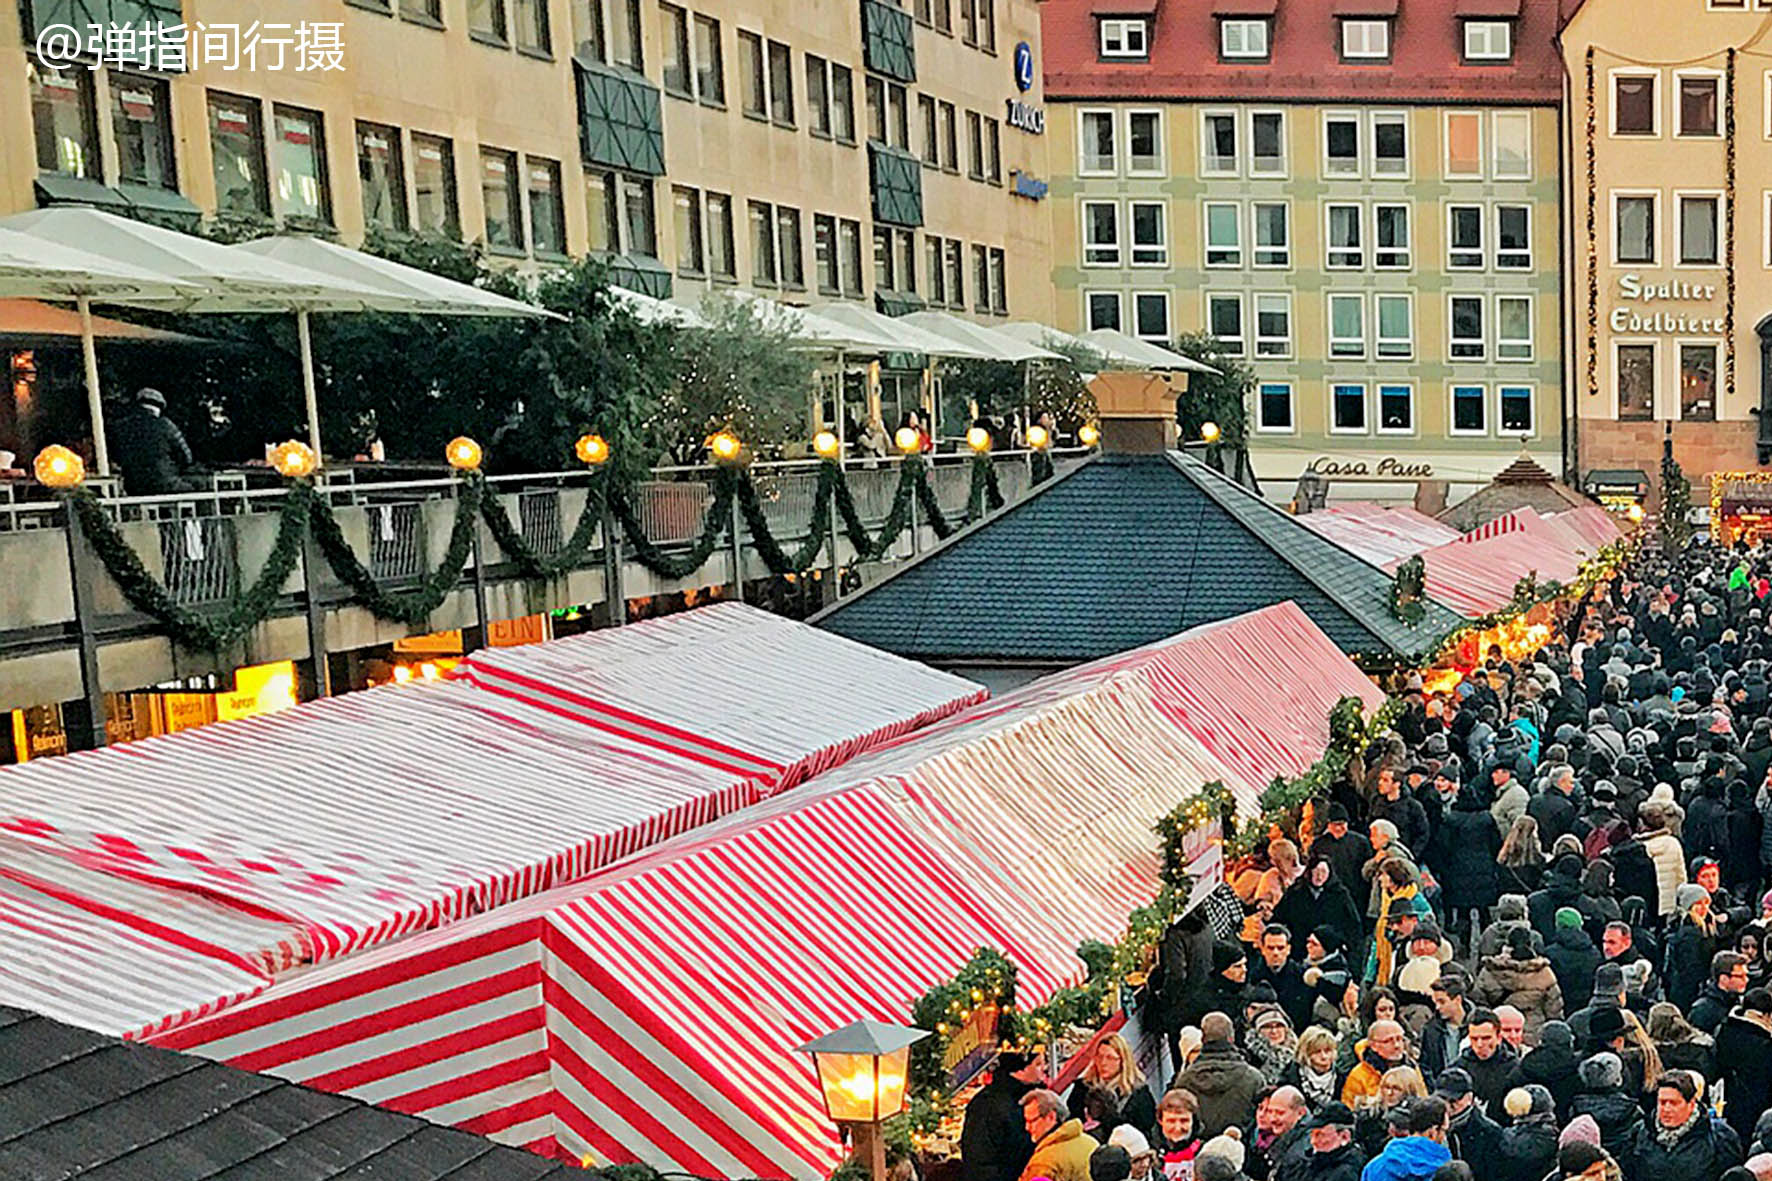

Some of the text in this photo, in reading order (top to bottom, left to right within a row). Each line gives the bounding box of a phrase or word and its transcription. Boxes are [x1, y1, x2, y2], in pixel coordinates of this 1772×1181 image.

[1619, 273, 1716, 302] Spalter
[1609, 307, 1725, 332] Edelbiere
[1312, 456, 1434, 477] Casa Pane
